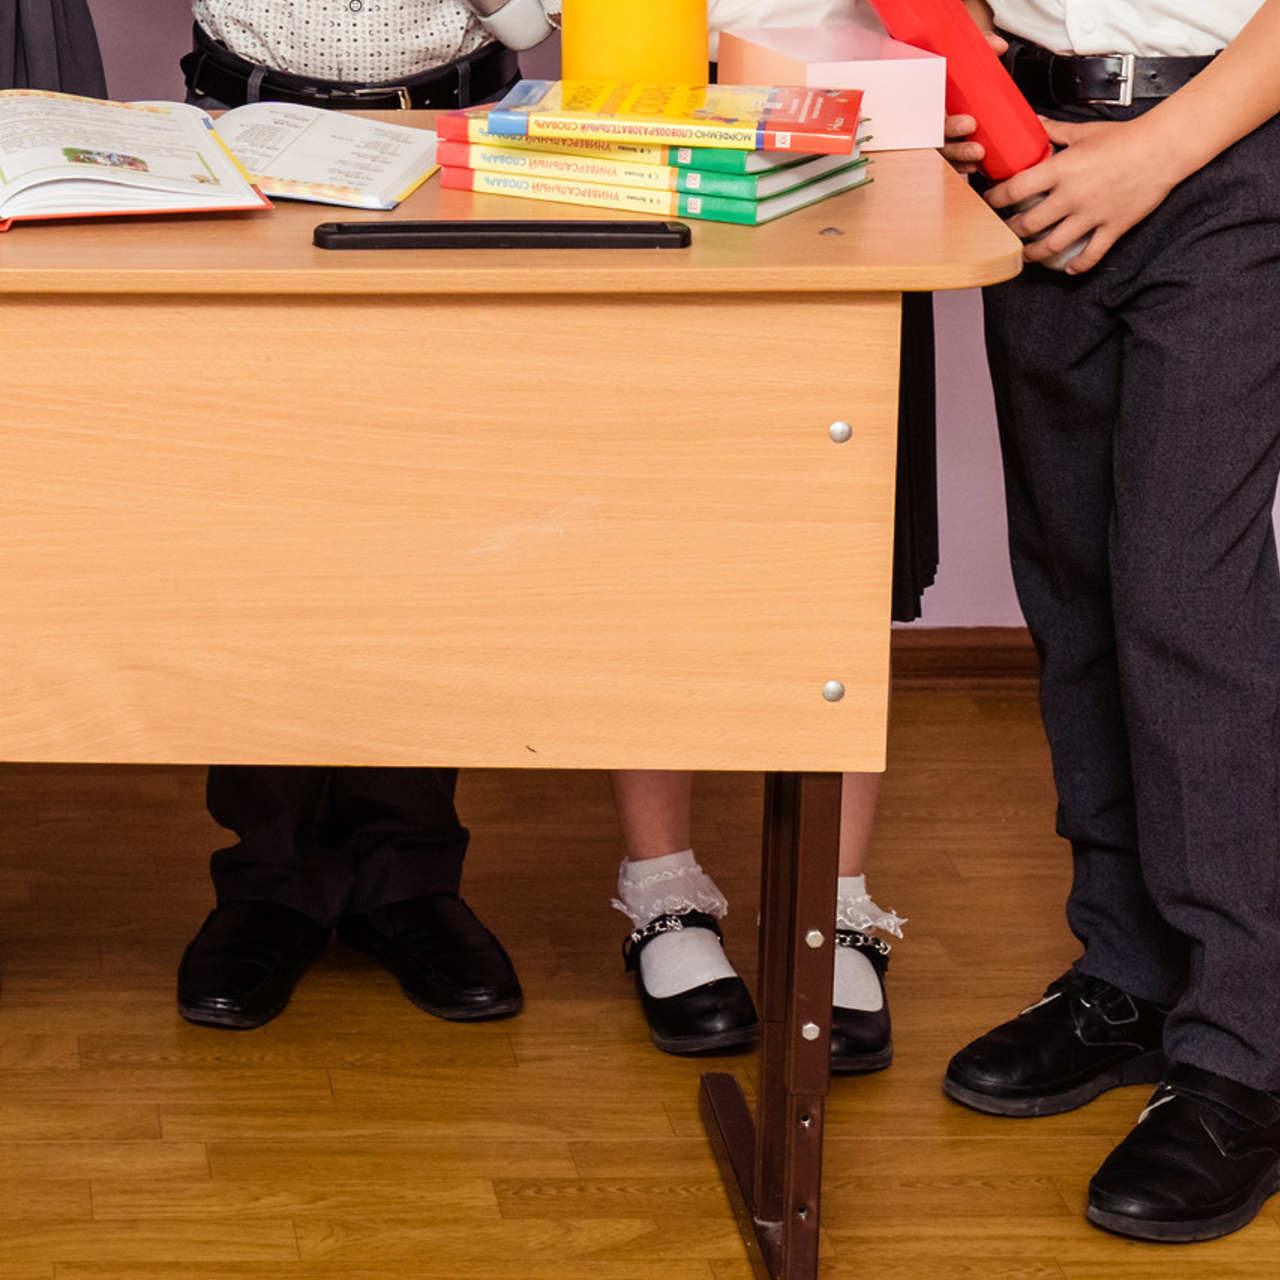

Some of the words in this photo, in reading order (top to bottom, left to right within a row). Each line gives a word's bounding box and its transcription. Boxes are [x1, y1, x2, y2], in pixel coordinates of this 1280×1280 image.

[534, 120, 578, 130] СЛОВАРЬ
[481, 153, 526, 167] СЛОВАРЬ
[529, 158, 617, 176] УНИВЕРСАЛЬНЫЙ
[484, 176, 529, 190] СЛОВАРЬ
[531, 182, 619, 200] УНИВЕРСАЛЬНЫЙ
